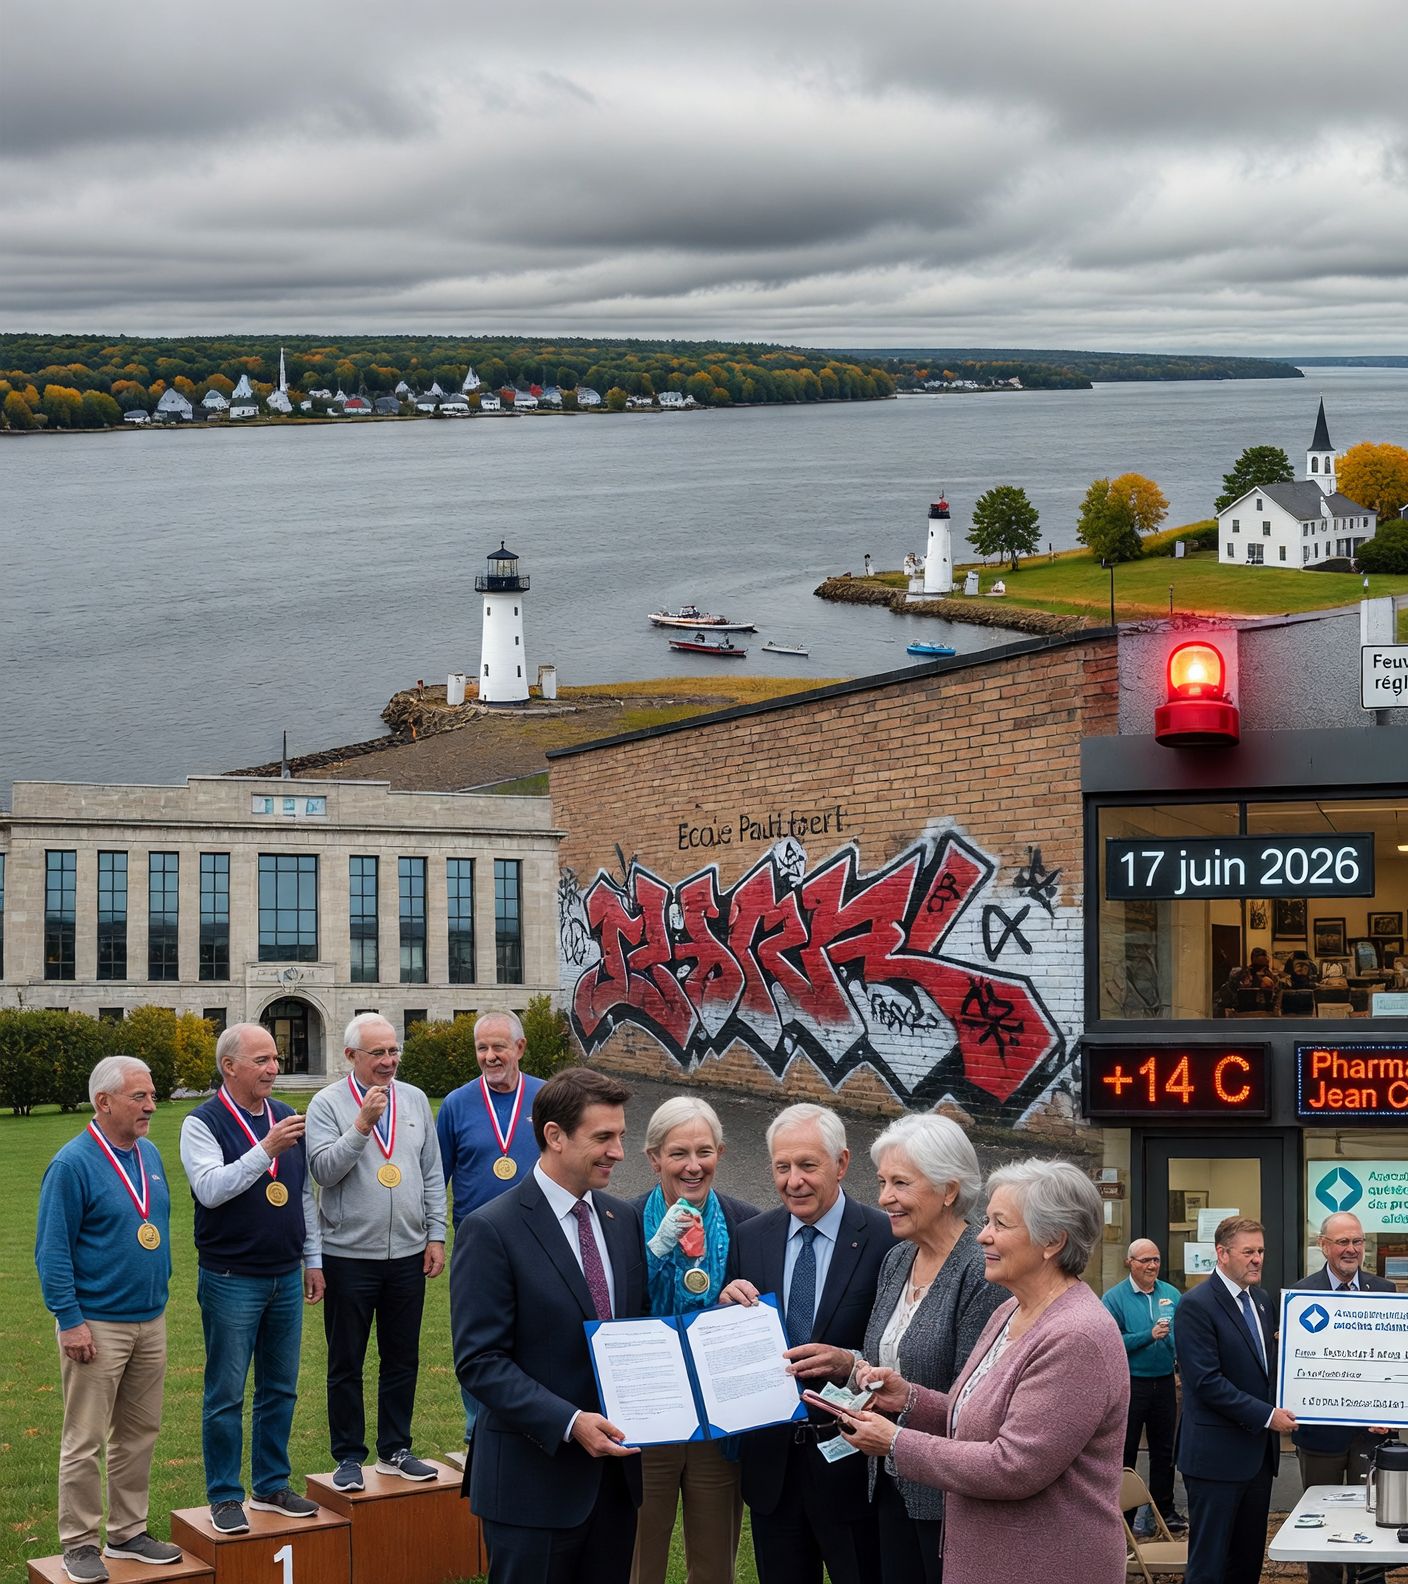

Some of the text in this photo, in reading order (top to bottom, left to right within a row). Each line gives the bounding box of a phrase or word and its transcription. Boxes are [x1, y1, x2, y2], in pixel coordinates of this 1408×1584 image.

[1119, 846, 1360, 895] 17 juin 2026
[1102, 1055, 1251, 1103] +14 C
[1308, 1080, 1378, 1108] Jean
[273, 1544, 294, 1584] 1
